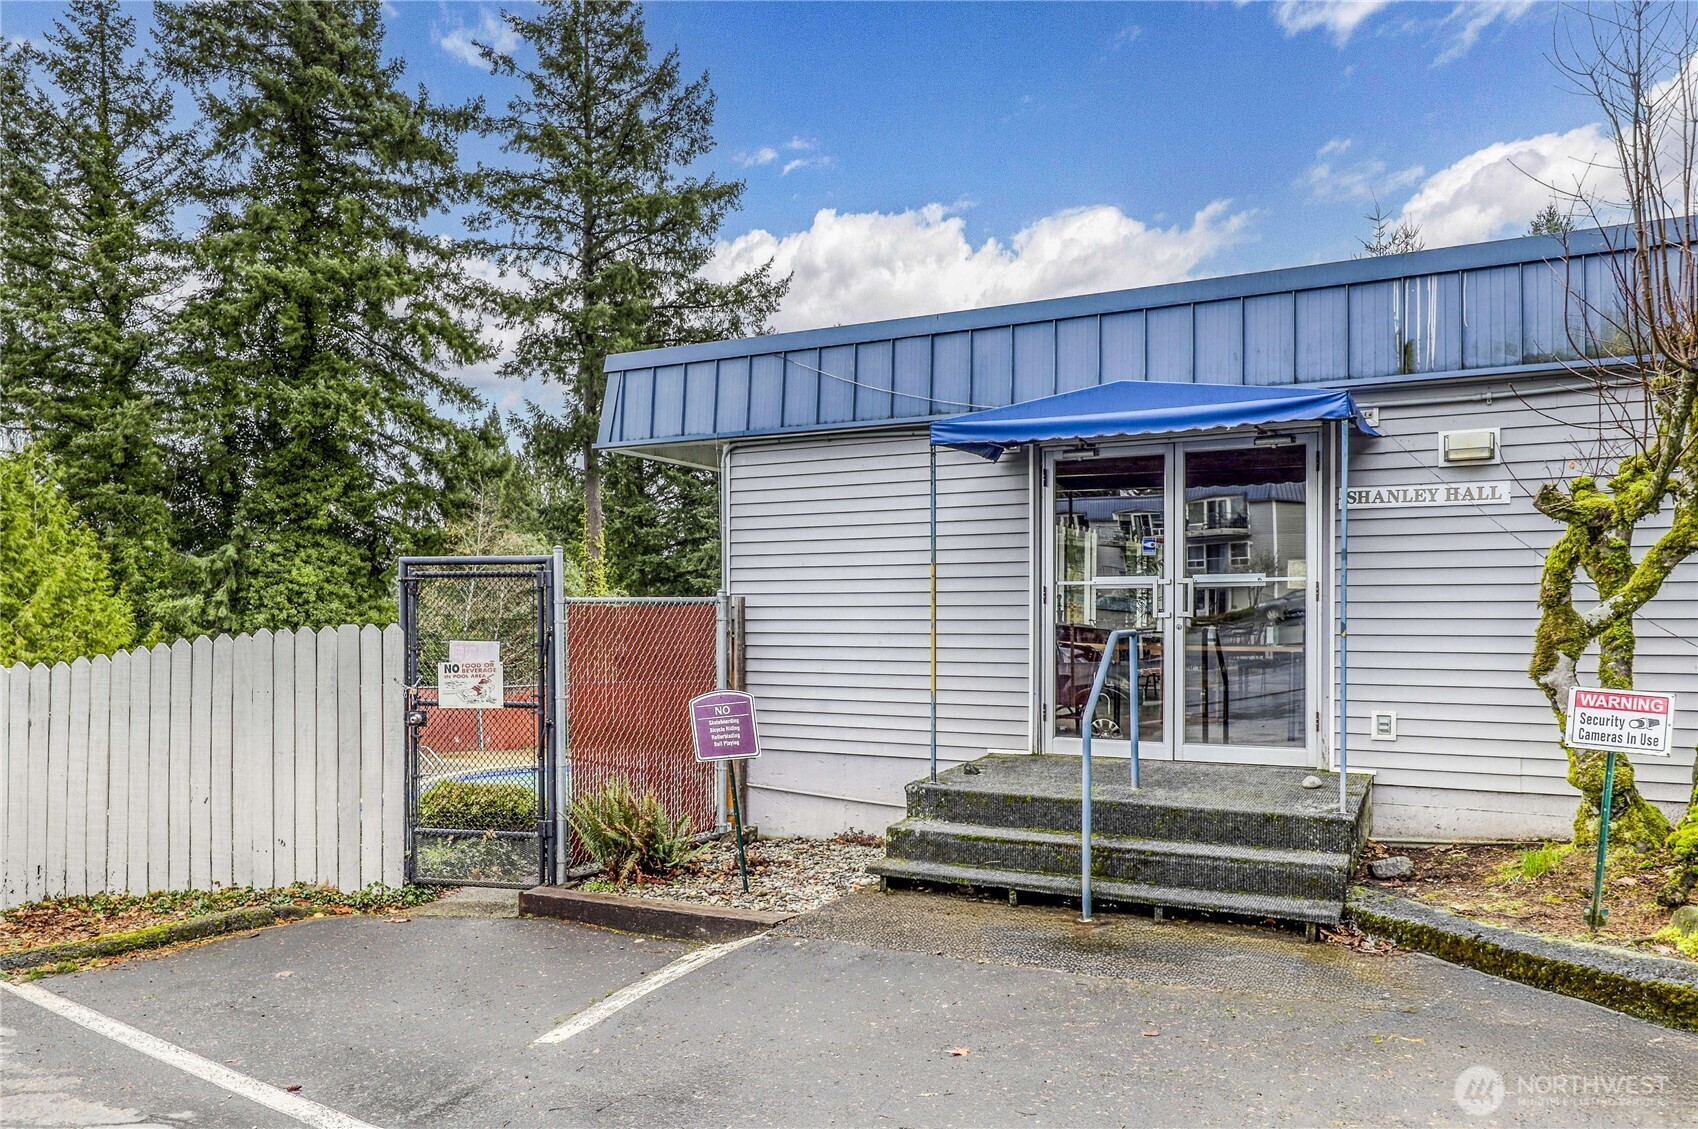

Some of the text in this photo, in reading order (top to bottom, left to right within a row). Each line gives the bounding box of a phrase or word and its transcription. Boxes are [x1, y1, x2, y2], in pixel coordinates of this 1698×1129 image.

[1347, 485, 1502, 504] SHANLEY HALL
[444, 664, 460, 674] NO
[714, 705, 730, 715] NO
[1580, 693, 1664, 712] WARNING
[1580, 712, 1625, 730] Security
[1579, 728, 1659, 747] Cameras In Use
